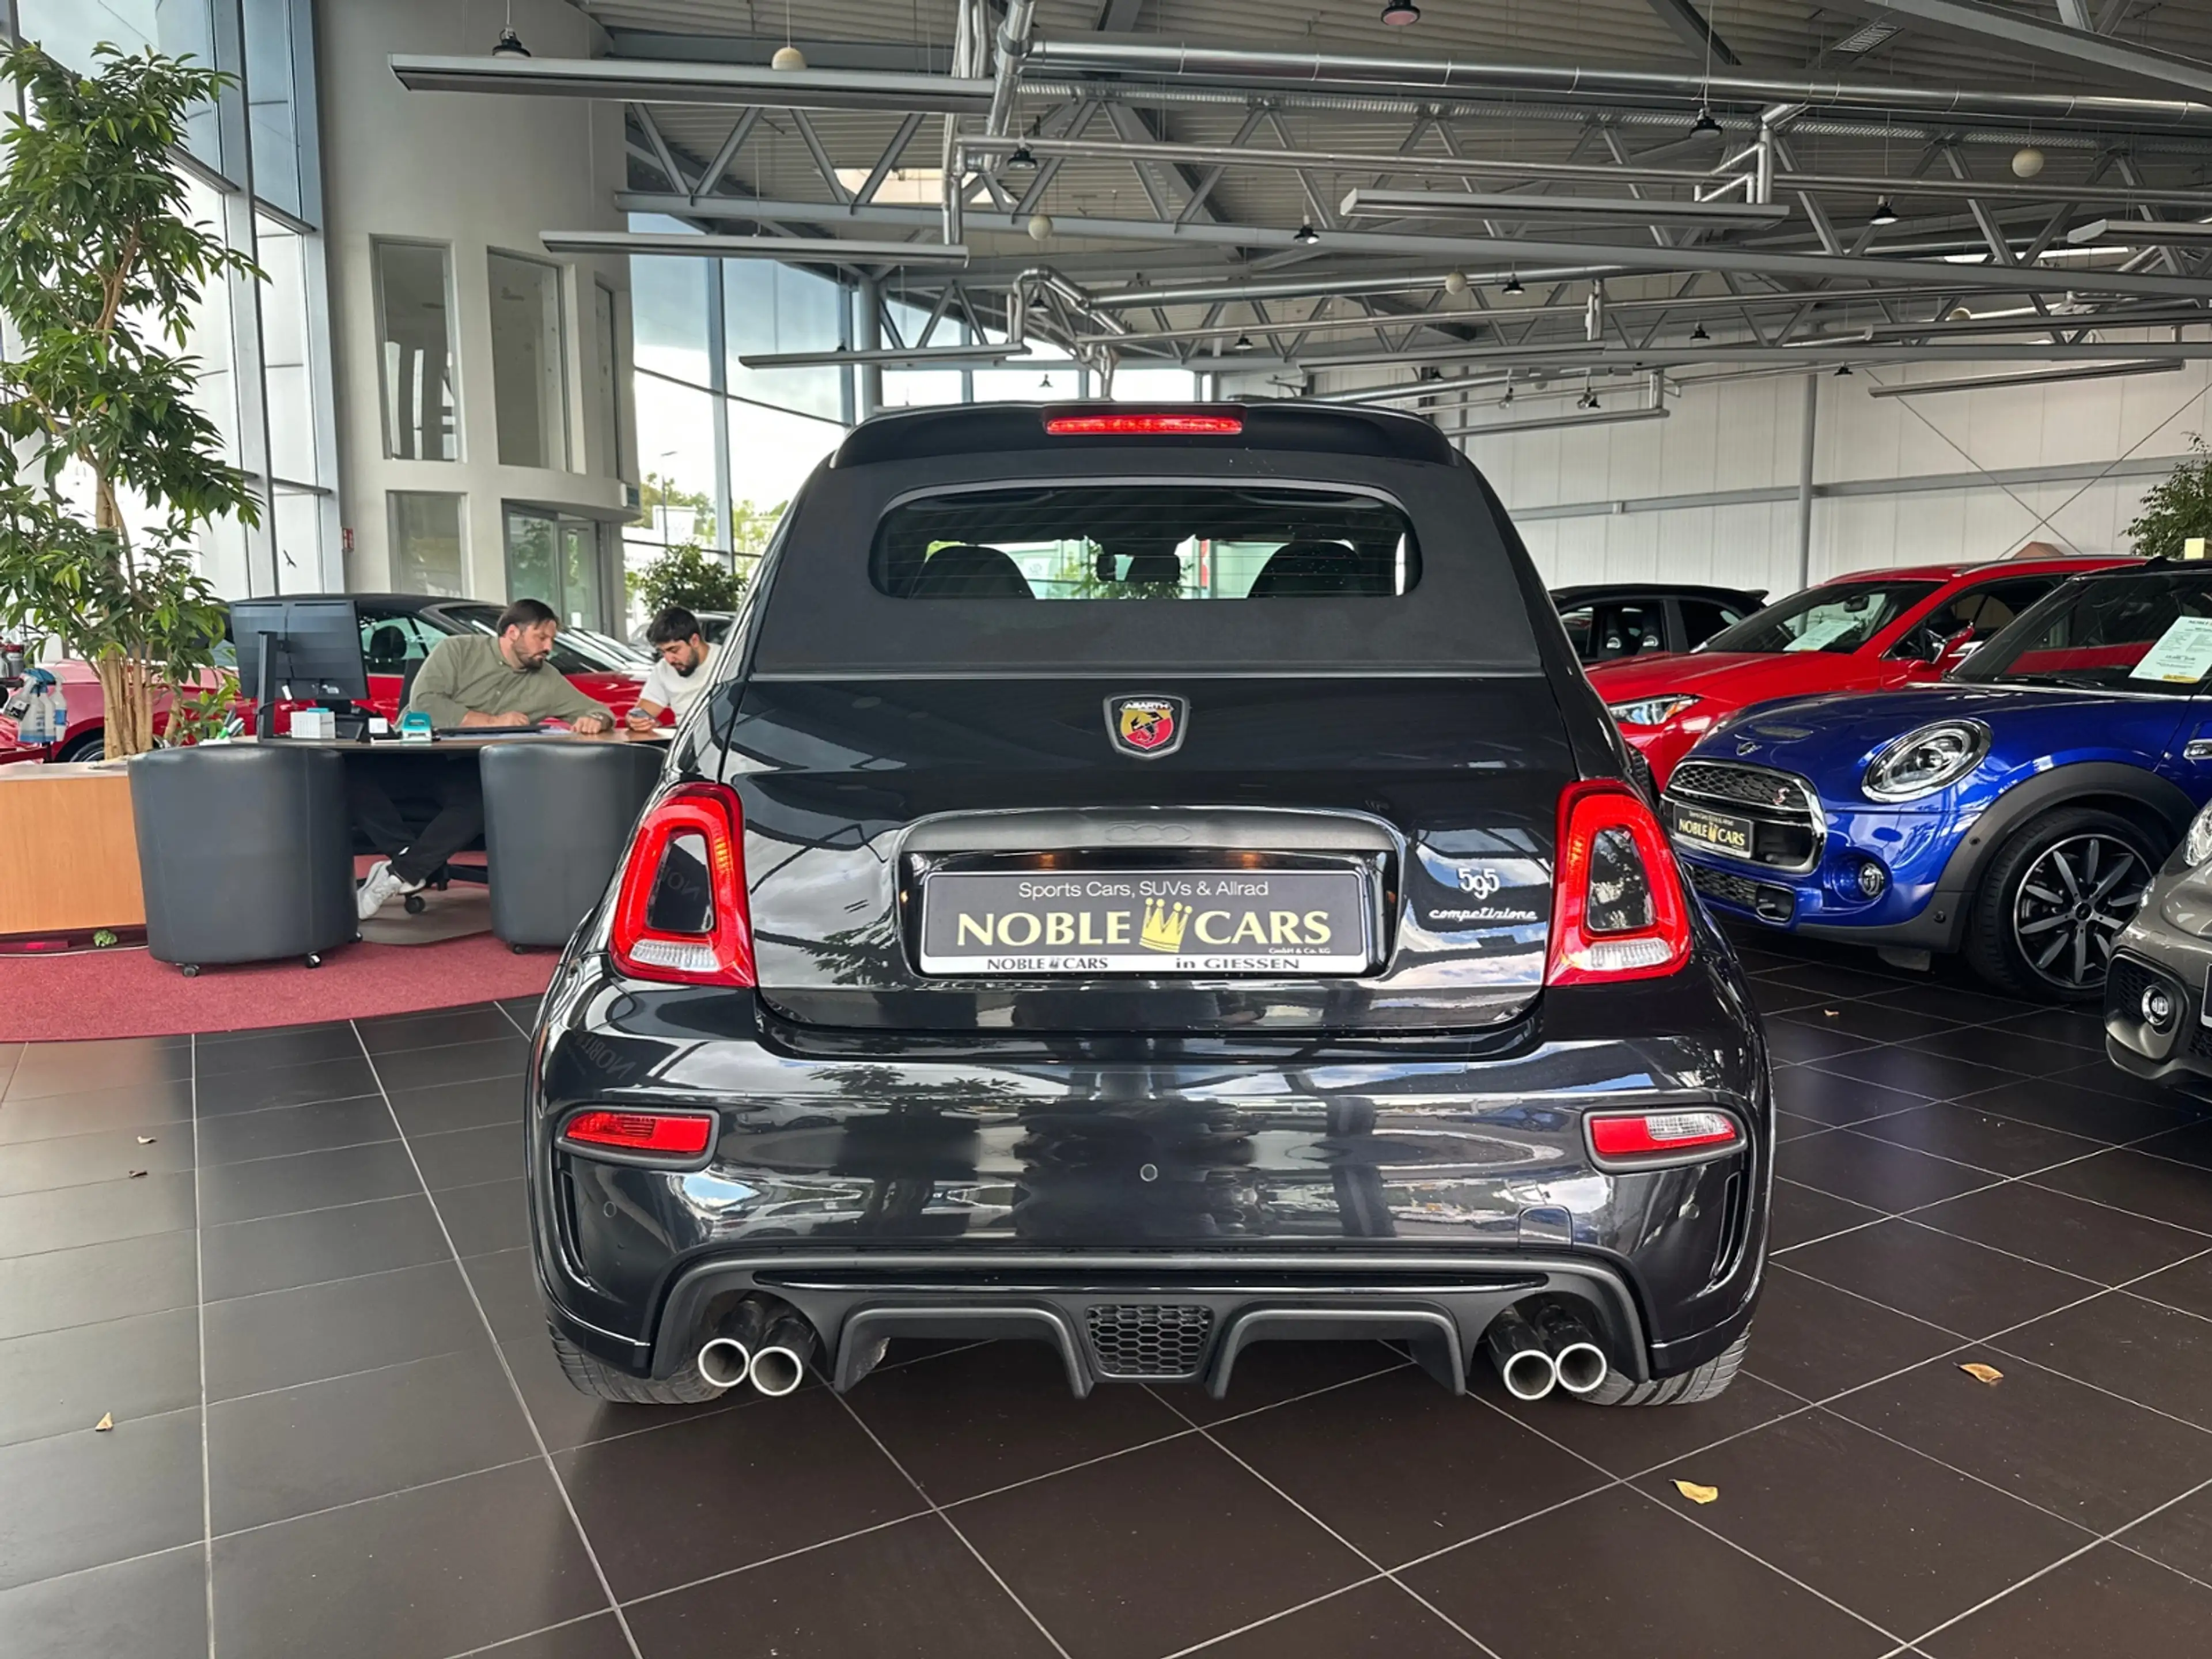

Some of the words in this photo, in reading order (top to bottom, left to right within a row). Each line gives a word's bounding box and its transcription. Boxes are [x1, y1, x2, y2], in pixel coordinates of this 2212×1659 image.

[1679, 819, 1707, 837] NOBLE
[1718, 828, 1745, 846] CARS
[1018, 882, 1081, 900] Sports
[1086, 881, 1135, 898] Cars,
[1139, 881, 1192, 896] SUVs
[1196, 881, 1211, 896] &
[1215, 881, 1269, 896] Allrad
[1429, 907, 1538, 922] competizione
[957, 911, 1131, 946] NOBLE
[1194, 911, 1332, 945] CARS
[986, 958, 1044, 970] NOBLE
[1063, 957, 1108, 969] CARS
[1176, 957, 1196, 969] in
[1203, 957, 1300, 969] GIESSEN
